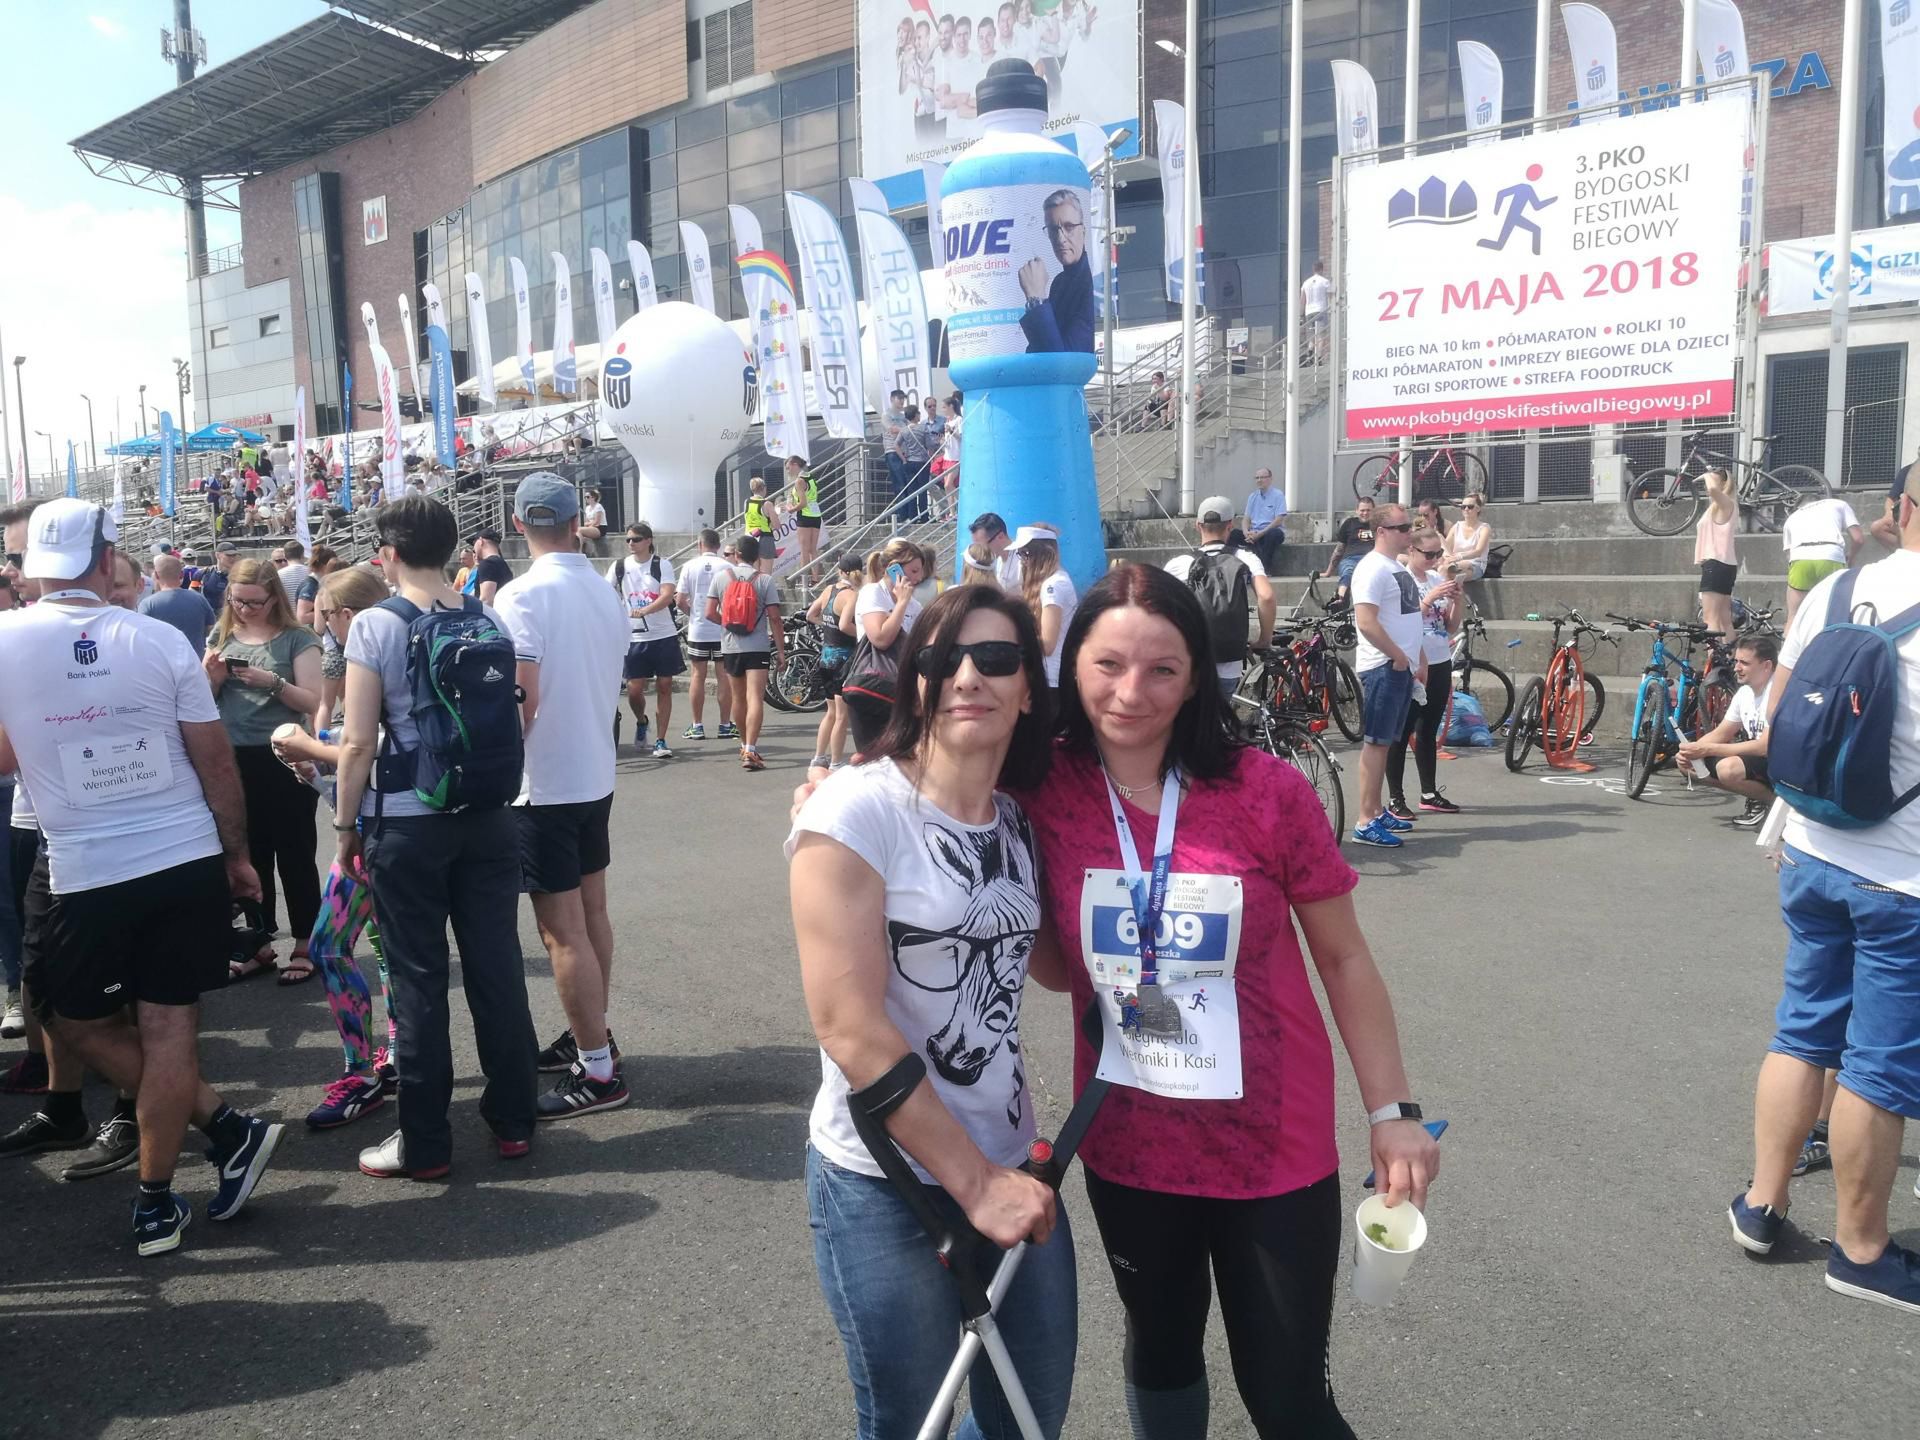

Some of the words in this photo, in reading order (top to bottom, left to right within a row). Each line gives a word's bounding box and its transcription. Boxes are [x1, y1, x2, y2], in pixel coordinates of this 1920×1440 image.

[906, 145, 949, 163] Mistrzowie
[1598, 145, 1645, 170] PKO
[1574, 163, 1689, 199] BYDGOSKI
[1574, 192, 1679, 225] FESTIWAL
[943, 218, 1014, 264] OVE
[1573, 217, 1679, 250] BIEGOWY
[984, 258, 1010, 270] drink
[1378, 287, 1424, 321] 27
[1441, 271, 1564, 315] MAJA
[1583, 252, 1699, 297] 2018
[1386, 345, 1415, 358] BIEG
[1419, 343, 1438, 355] NA
[1443, 340, 1457, 353] 10
[1461, 339, 1481, 351] km
[1497, 327, 1597, 347] PÓŁMARATON
[1616, 319, 1662, 335] ROLKI
[1668, 316, 1686, 331] 10
[1352, 367, 1388, 381] ROLKI
[1393, 357, 1483, 377] PÓŁMARATON
[1500, 350, 1561, 368] IMPREZY
[1566, 343, 1636, 361] BIEGOWE
[1641, 340, 1671, 354] DLA
[1677, 333, 1730, 351] DZIECI
[1393, 382, 1430, 396] TARGI
[1434, 375, 1508, 393] SPORTOWE
[1525, 370, 1575, 386] STREFA
[1580, 361, 1673, 381] FOODTRUCK
[1362, 388, 1712, 429] www.pkobydgoskifestiwalbiegowy.pl
[623, 423, 655, 437] Polski
[67, 671, 87, 680] Bank
[88, 668, 111, 678] Polski
[82, 774, 128, 791] Weroniki
[136, 770, 157, 781] Kasi
[91, 764, 126, 777] biegnę
[128, 760, 144, 770] dla
[1156, 860, 1166, 880] 10km
[1151, 880, 1164, 912] dystans
[1135, 946, 1181, 959] Aeszka
[1119, 1043, 1168, 1068] Weroniki
[1174, 1053, 1178, 1068] i
[1184, 1053, 1216, 1069] Kasi
